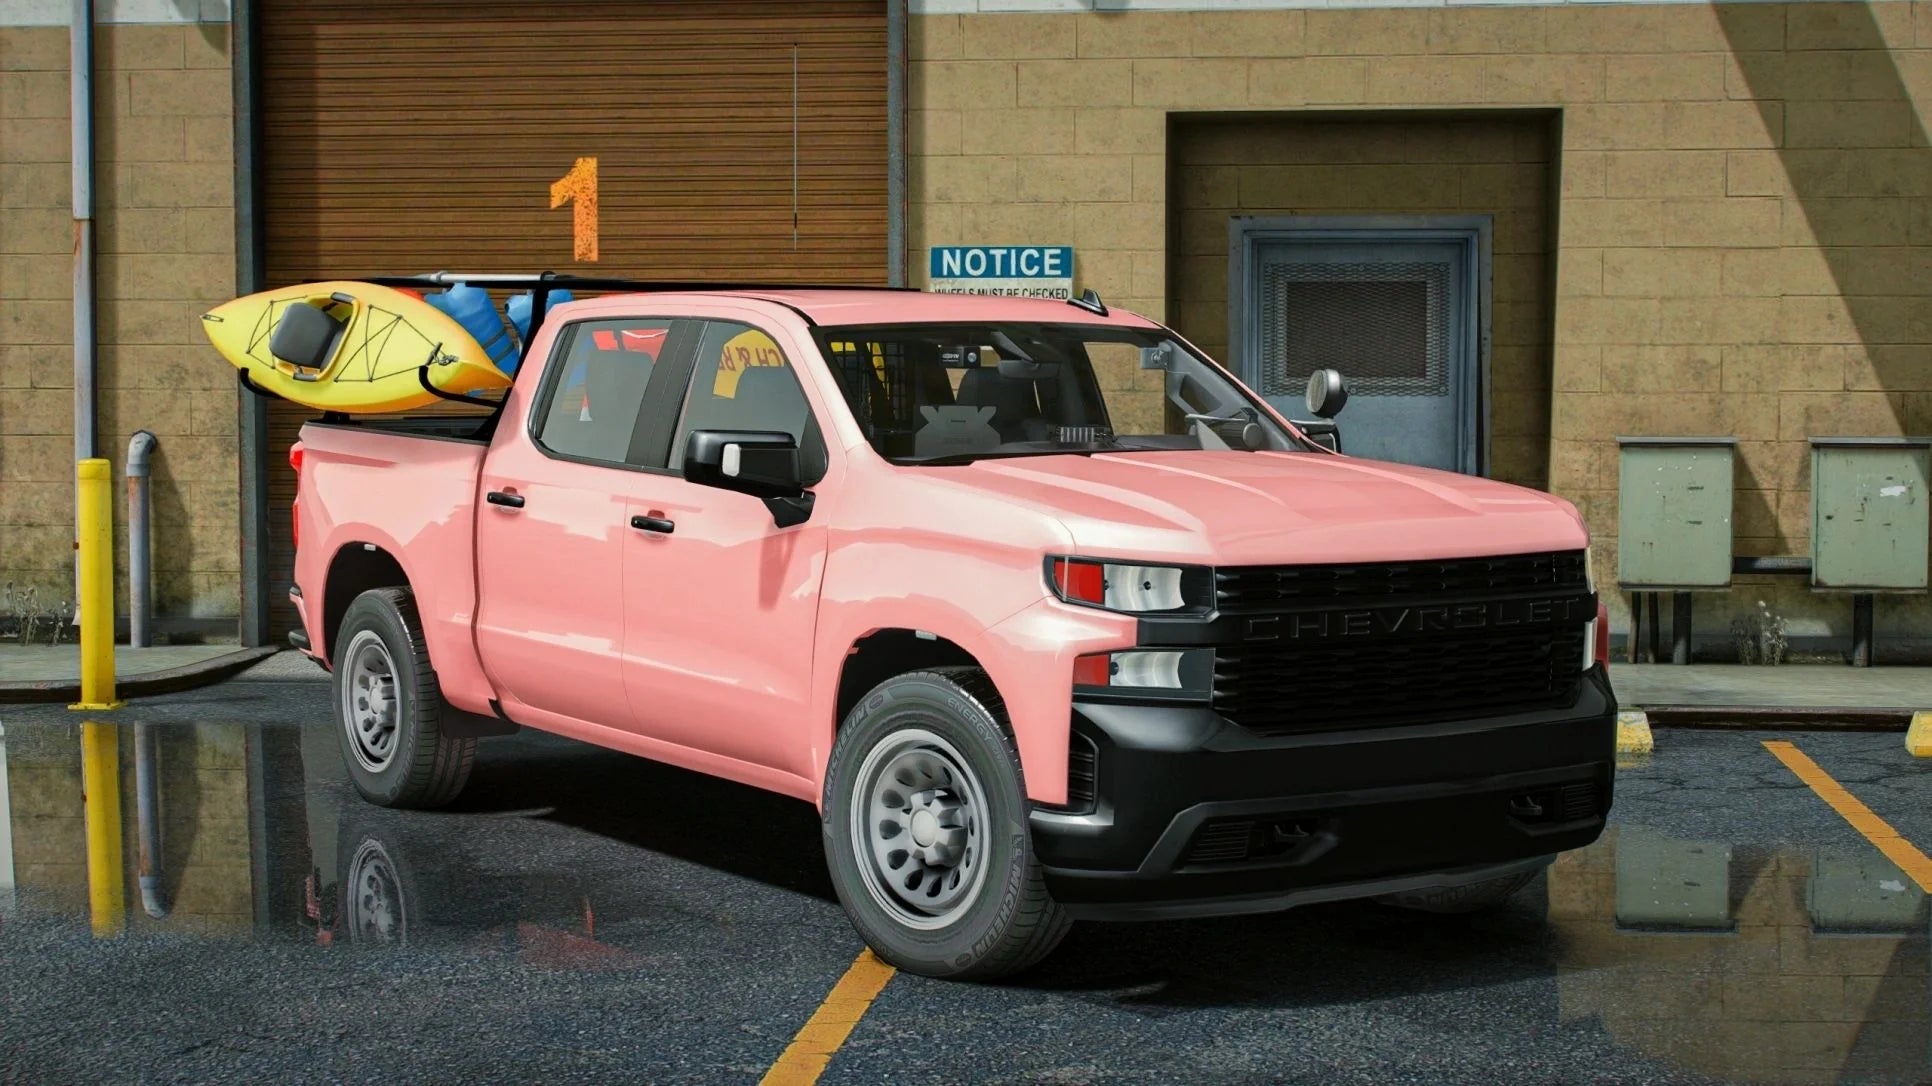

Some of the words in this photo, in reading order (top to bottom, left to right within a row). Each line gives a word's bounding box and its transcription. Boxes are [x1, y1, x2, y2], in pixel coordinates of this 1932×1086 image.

[550, 157, 598, 261] 1
[942, 248, 1062, 276] NOTICE
[1022, 288, 1068, 299] CHECKED
[1243, 598, 1580, 640] CHEVROLET
[947, 697, 993, 741] ENERGY
[974, 862, 1021, 958] MICHELIN
